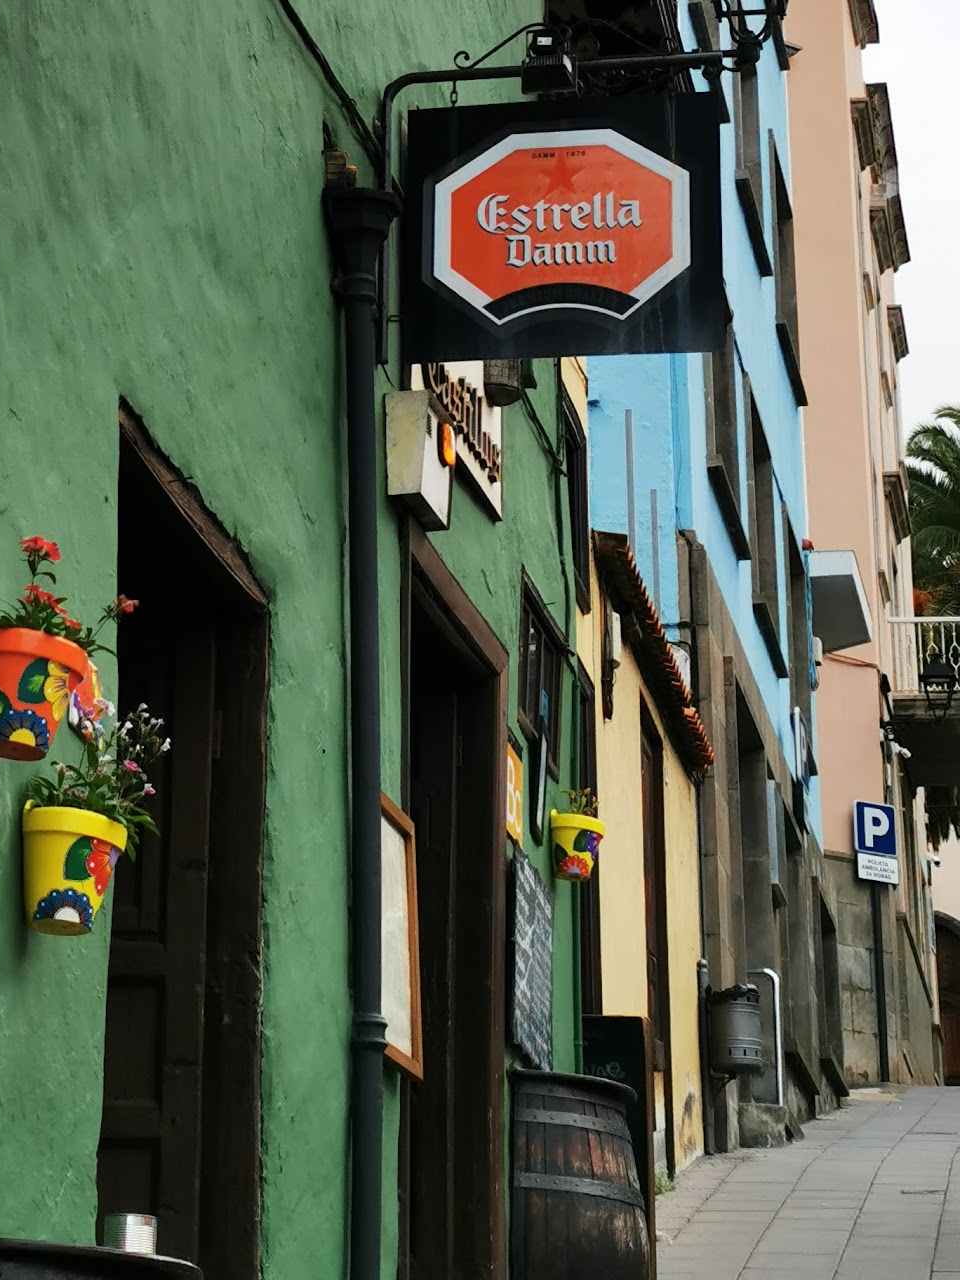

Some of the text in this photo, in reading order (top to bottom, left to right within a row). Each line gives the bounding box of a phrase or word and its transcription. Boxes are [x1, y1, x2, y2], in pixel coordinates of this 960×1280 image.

[477, 191, 643, 235] Estrella
[505, 235, 618, 268] Damm
[864, 806, 890, 848] P
[861, 864, 895, 874] AMBULANCIA
[873, 872, 891, 880] HORAS
